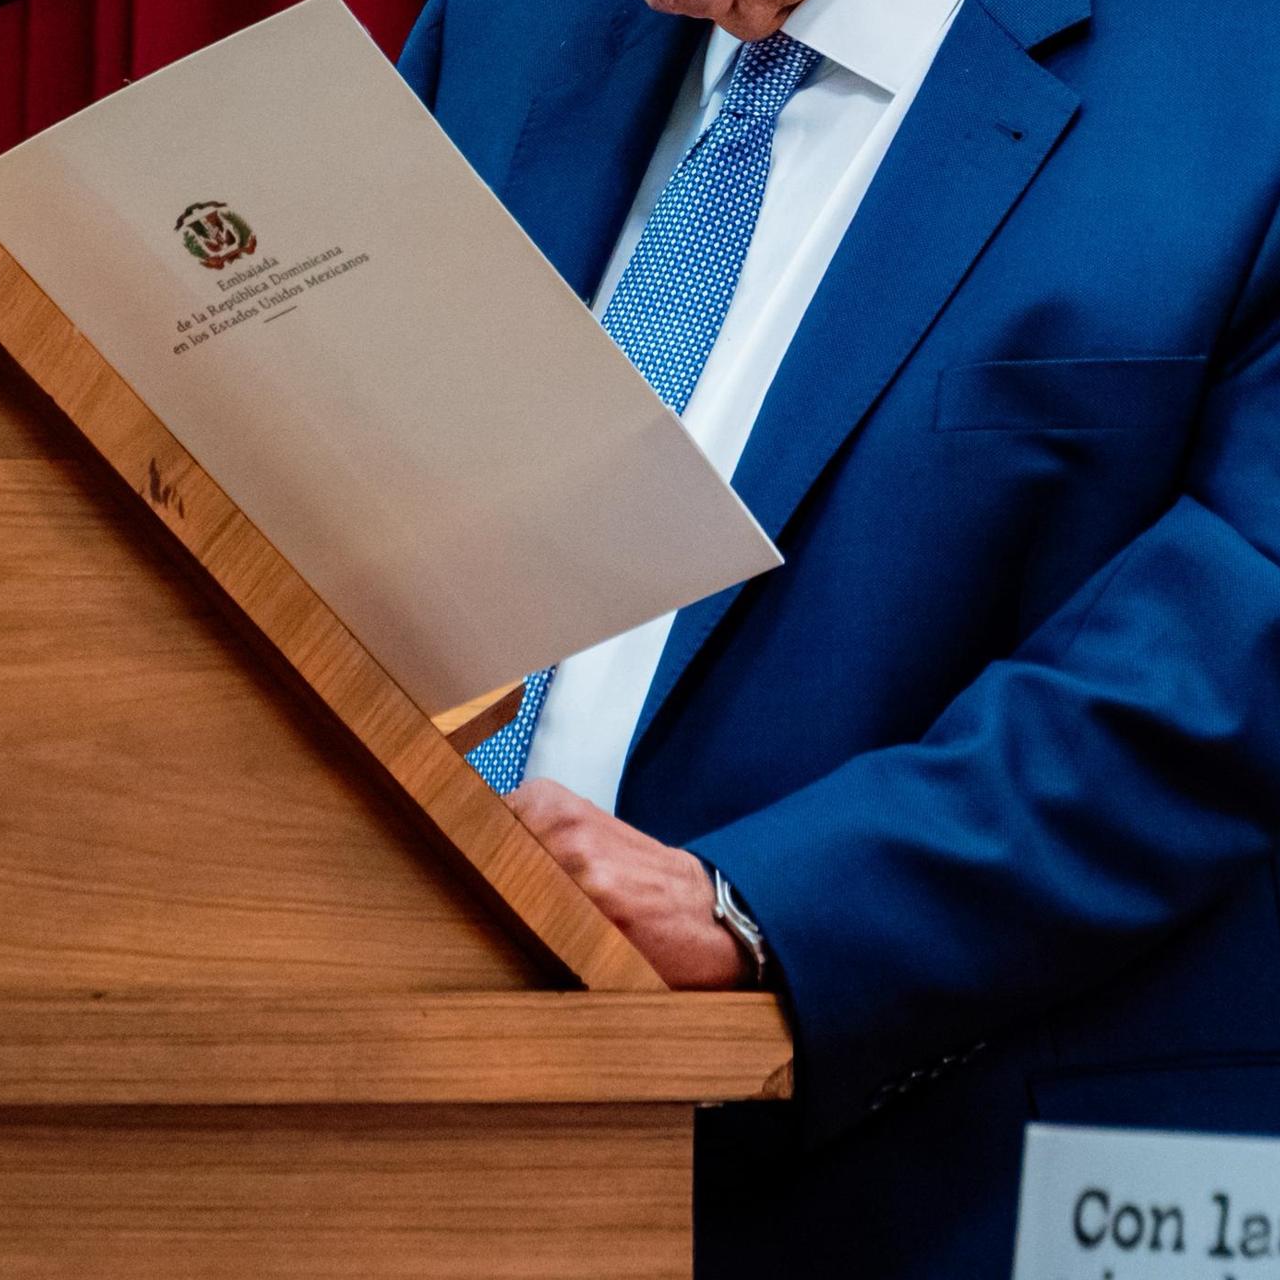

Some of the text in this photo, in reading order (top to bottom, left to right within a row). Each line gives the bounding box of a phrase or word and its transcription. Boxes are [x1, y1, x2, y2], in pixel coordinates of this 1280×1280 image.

[173, 251, 370, 356] en los Estados Unidos Mexicanos
[176, 245, 344, 334] de la República Dominicana
[216, 256, 280, 293] Embajada
[1073, 1186, 1185, 1254] Con
